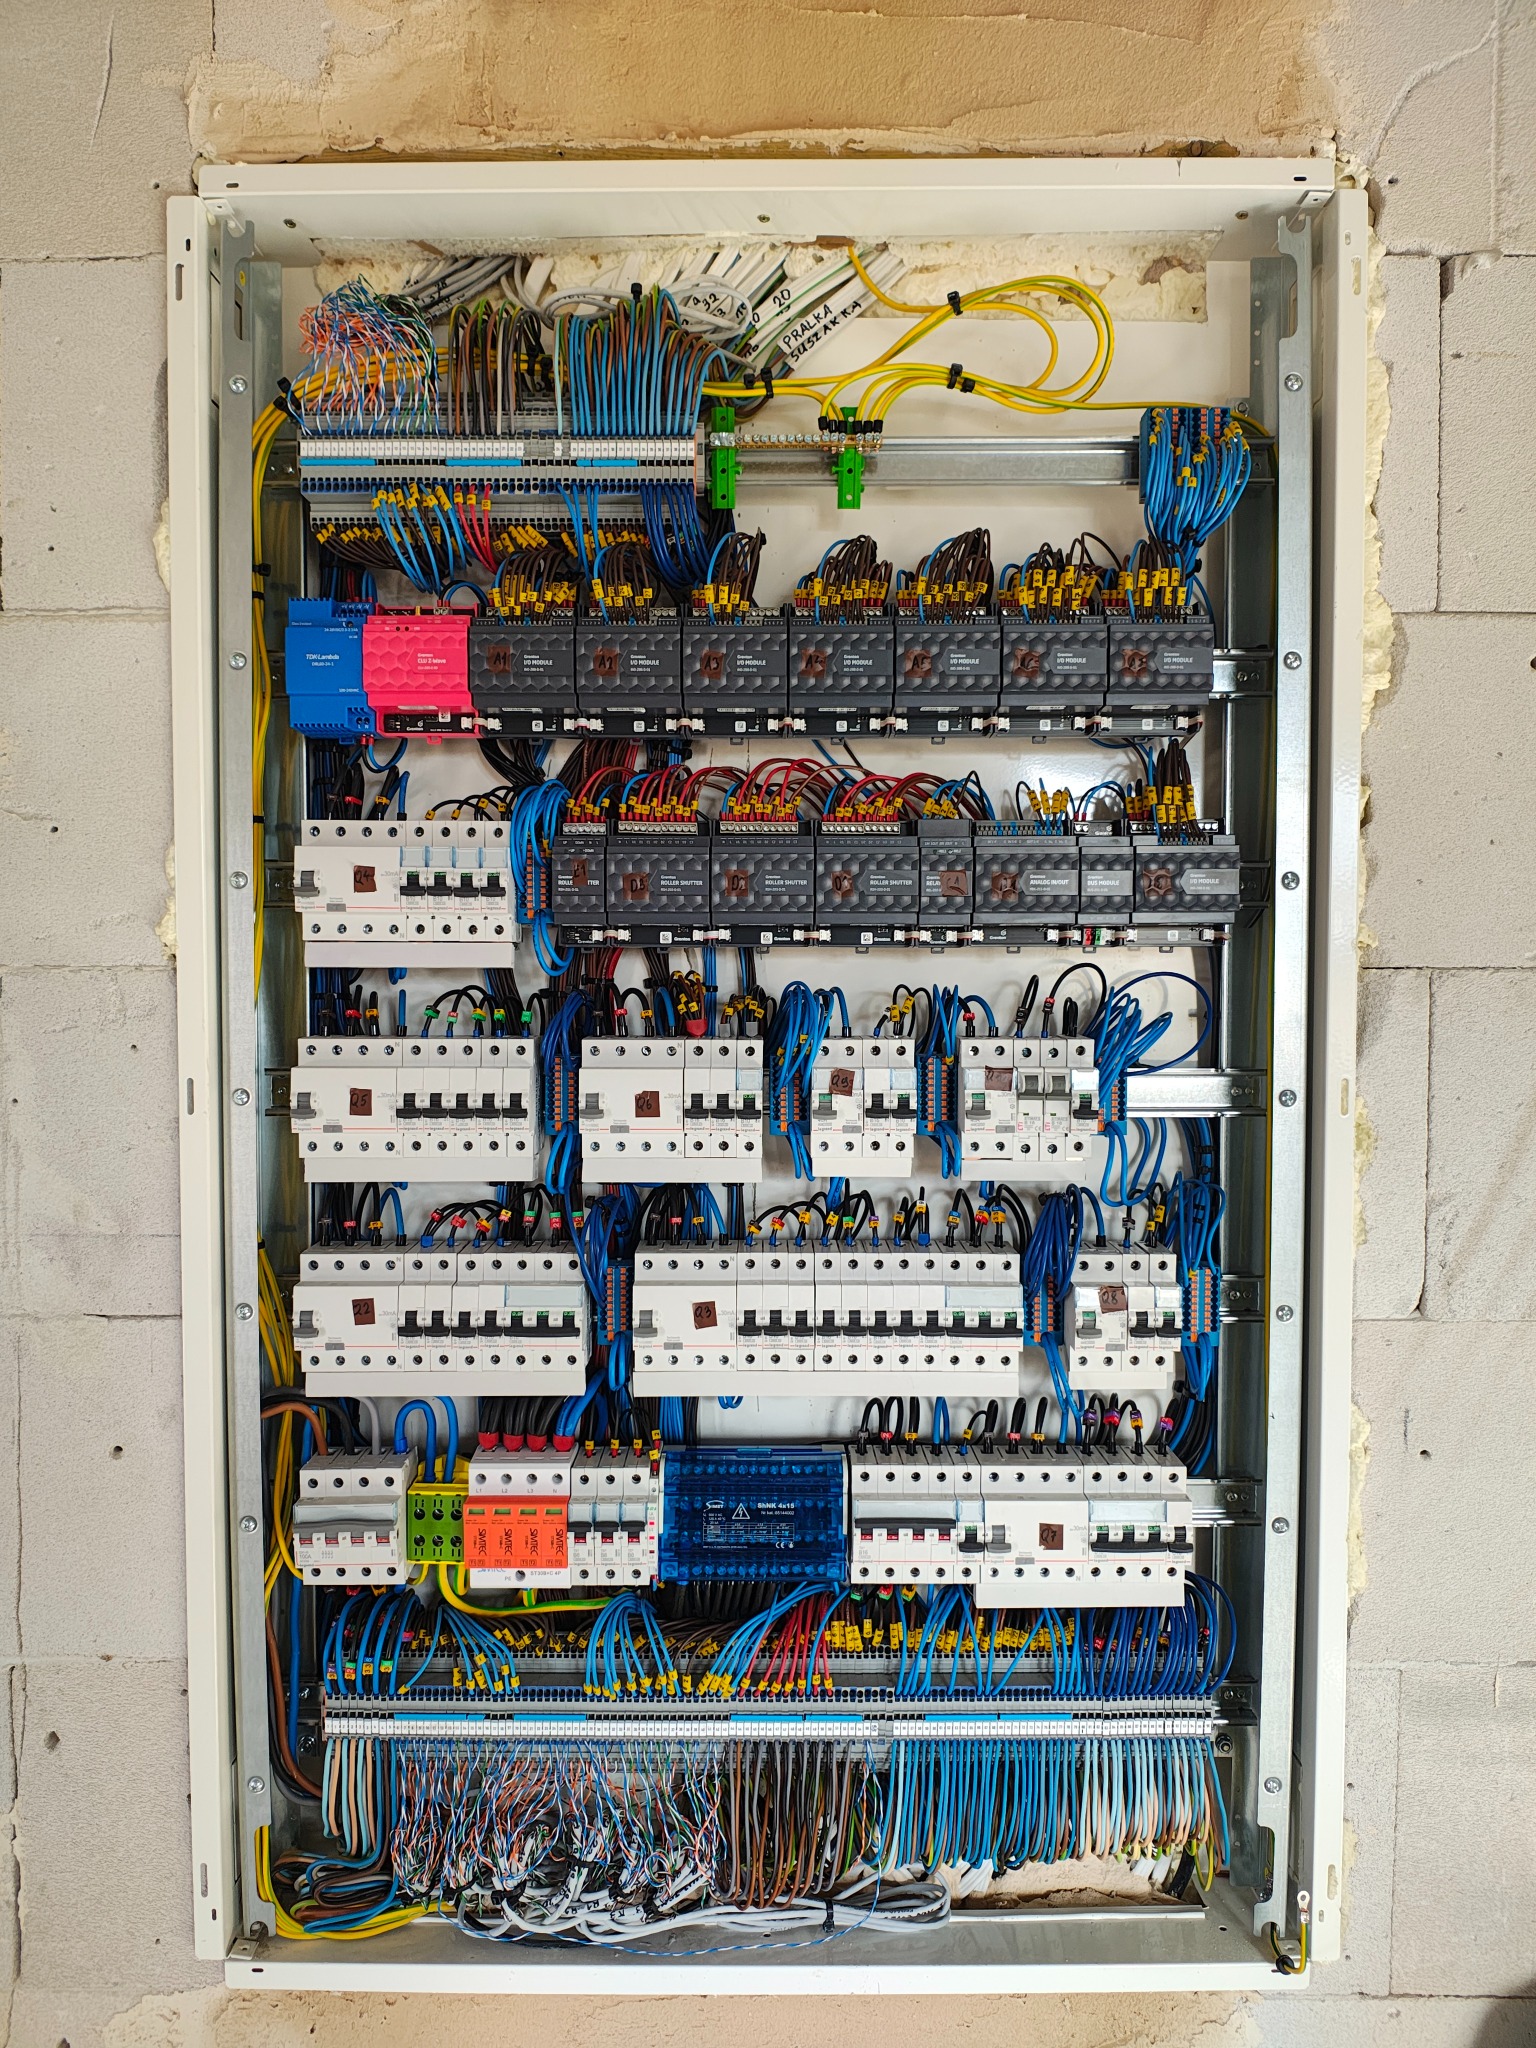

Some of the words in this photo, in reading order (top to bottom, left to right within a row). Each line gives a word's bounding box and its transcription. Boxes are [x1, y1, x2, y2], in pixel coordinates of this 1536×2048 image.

[772, 288, 791, 308] 20
[782, 304, 833, 349] PRALKA
[599, 655, 613, 670] A2
[704, 655, 720, 671] A3
[350, 1093, 368, 1108] Q5
[636, 1097, 652, 1112] Q6
[1102, 1290, 1118, 1305] Q8
[694, 1305, 712, 1319] Q3
[478, 1528, 487, 1556] SIMTEC
[504, 1528, 513, 1556] SIMTEC
[530, 1528, 539, 1556] SIMTEC
[556, 1528, 565, 1556] SIMTEC
[1040, 1527, 1057, 1543] Q7
